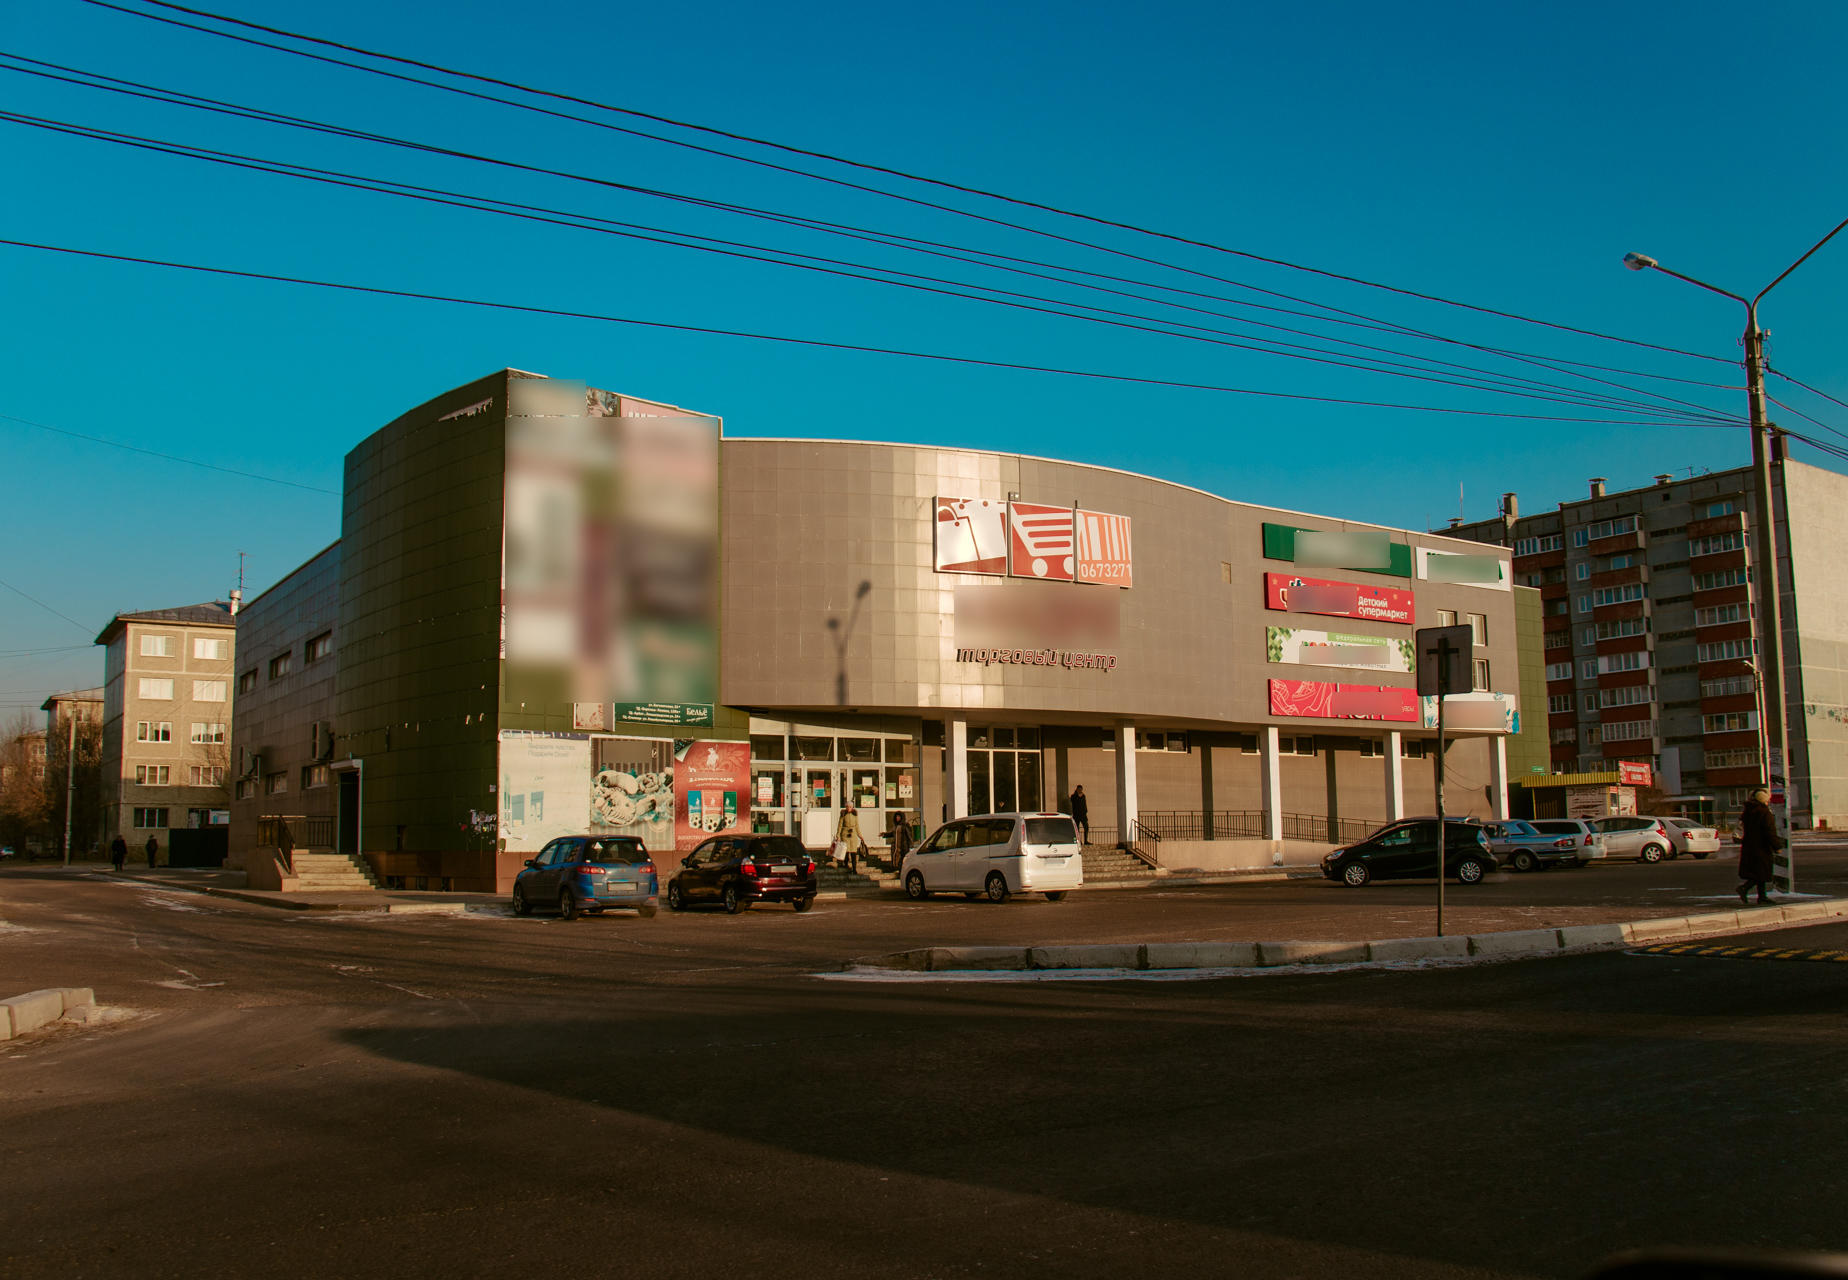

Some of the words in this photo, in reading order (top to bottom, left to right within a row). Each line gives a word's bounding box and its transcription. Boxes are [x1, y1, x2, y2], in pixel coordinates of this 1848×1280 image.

[1080, 563, 1132, 578] 0673271
[1358, 596, 1388, 608] Детский
[1358, 607, 1408, 620] супермаркет
[958, 648, 1060, 665] торговый
[1063, 651, 1118, 671] центр
